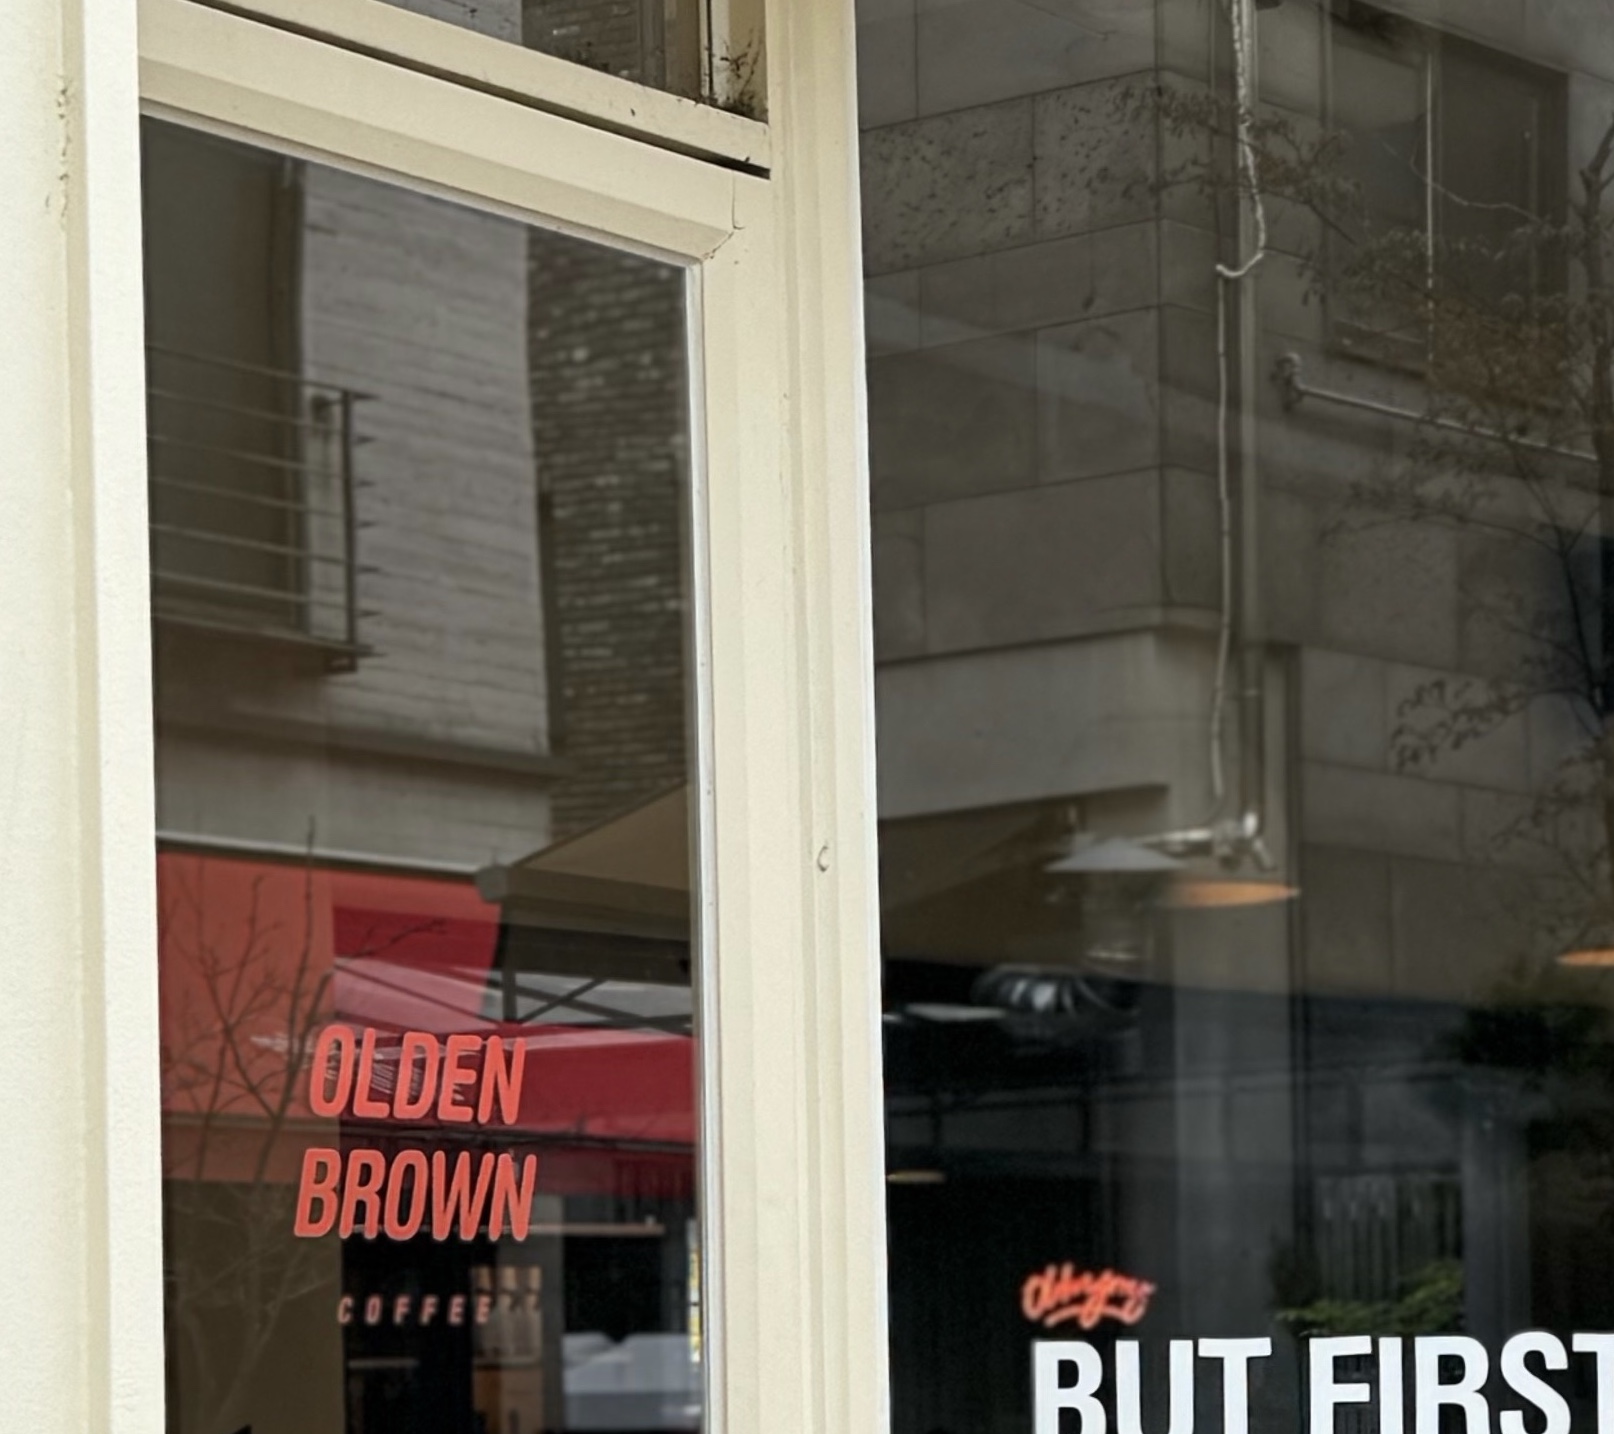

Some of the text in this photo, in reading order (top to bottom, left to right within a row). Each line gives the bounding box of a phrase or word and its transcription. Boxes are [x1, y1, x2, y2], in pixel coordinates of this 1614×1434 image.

[309, 1024, 526, 1124] OLDEN
[293, 1148, 537, 1241] BROWN
[336, 1294, 492, 1324] COFFEE
